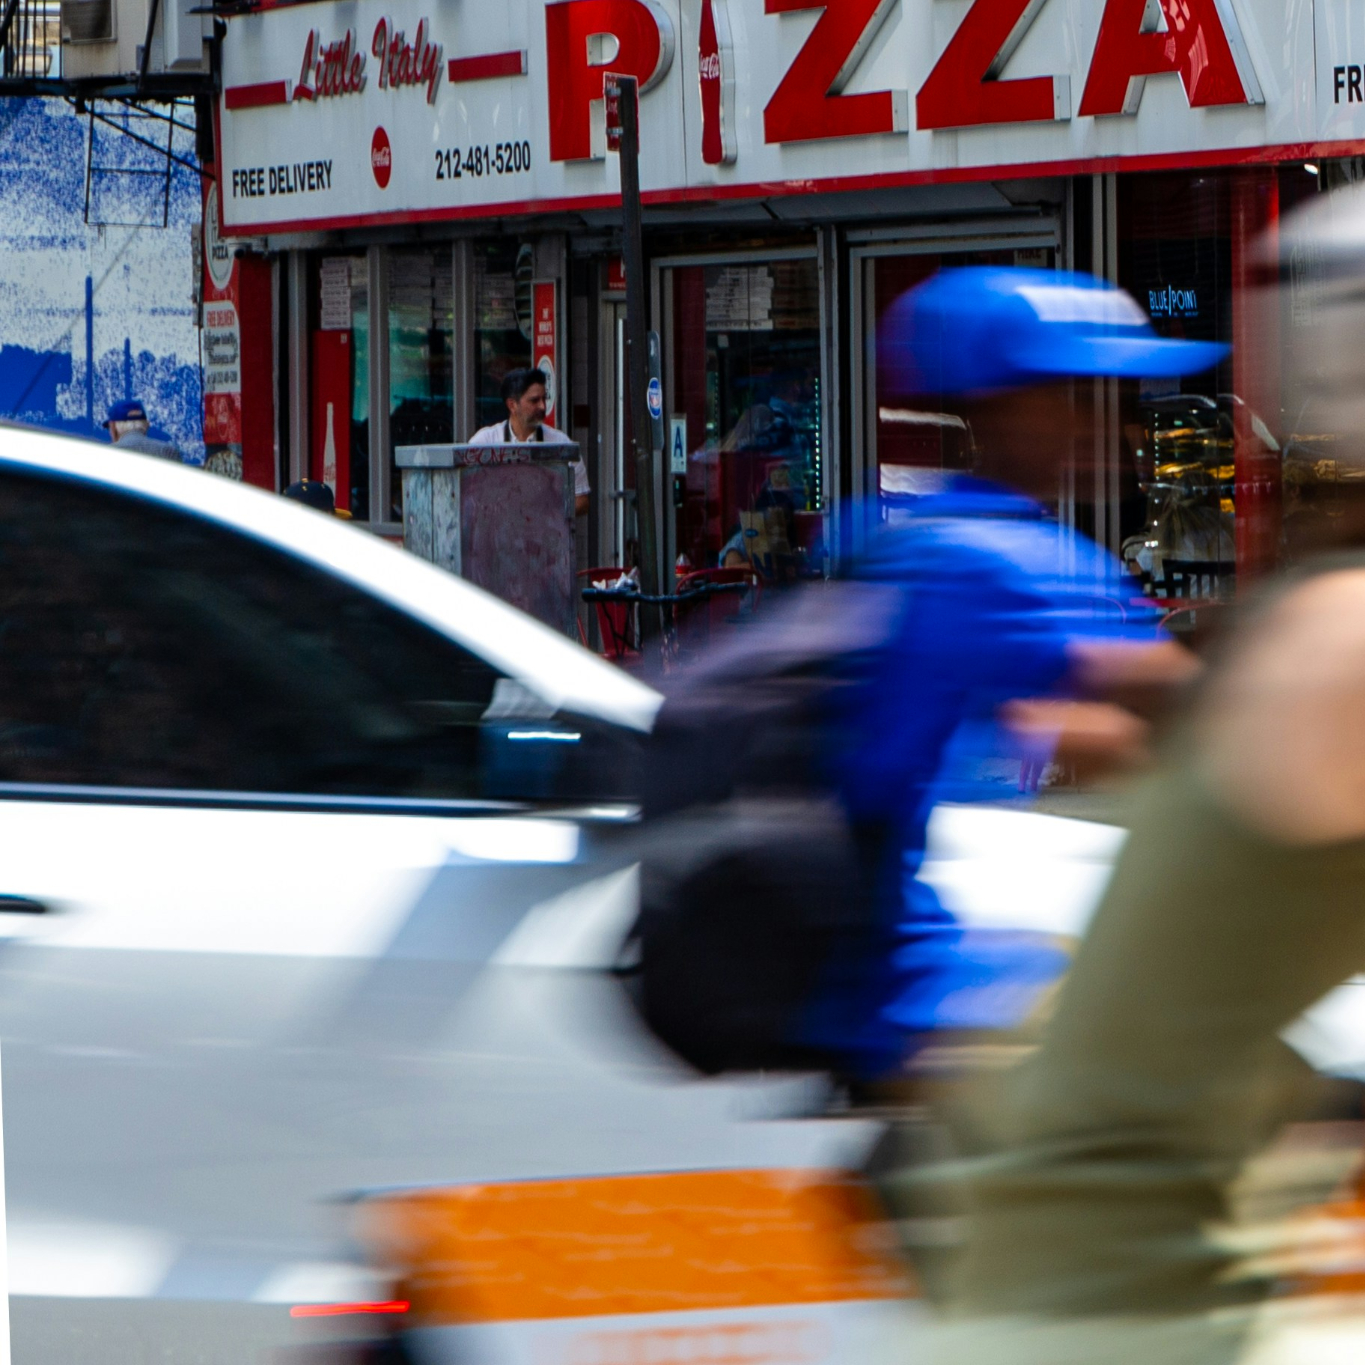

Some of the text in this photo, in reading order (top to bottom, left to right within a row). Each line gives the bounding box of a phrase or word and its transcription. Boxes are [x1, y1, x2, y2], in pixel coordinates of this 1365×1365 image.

[292, 16, 444, 105] Little Italy
[232, 159, 333, 198] FREE DELIVERY
[435, 140, 531, 181] 212-481-5200
[673, 426, 683, 458] A
